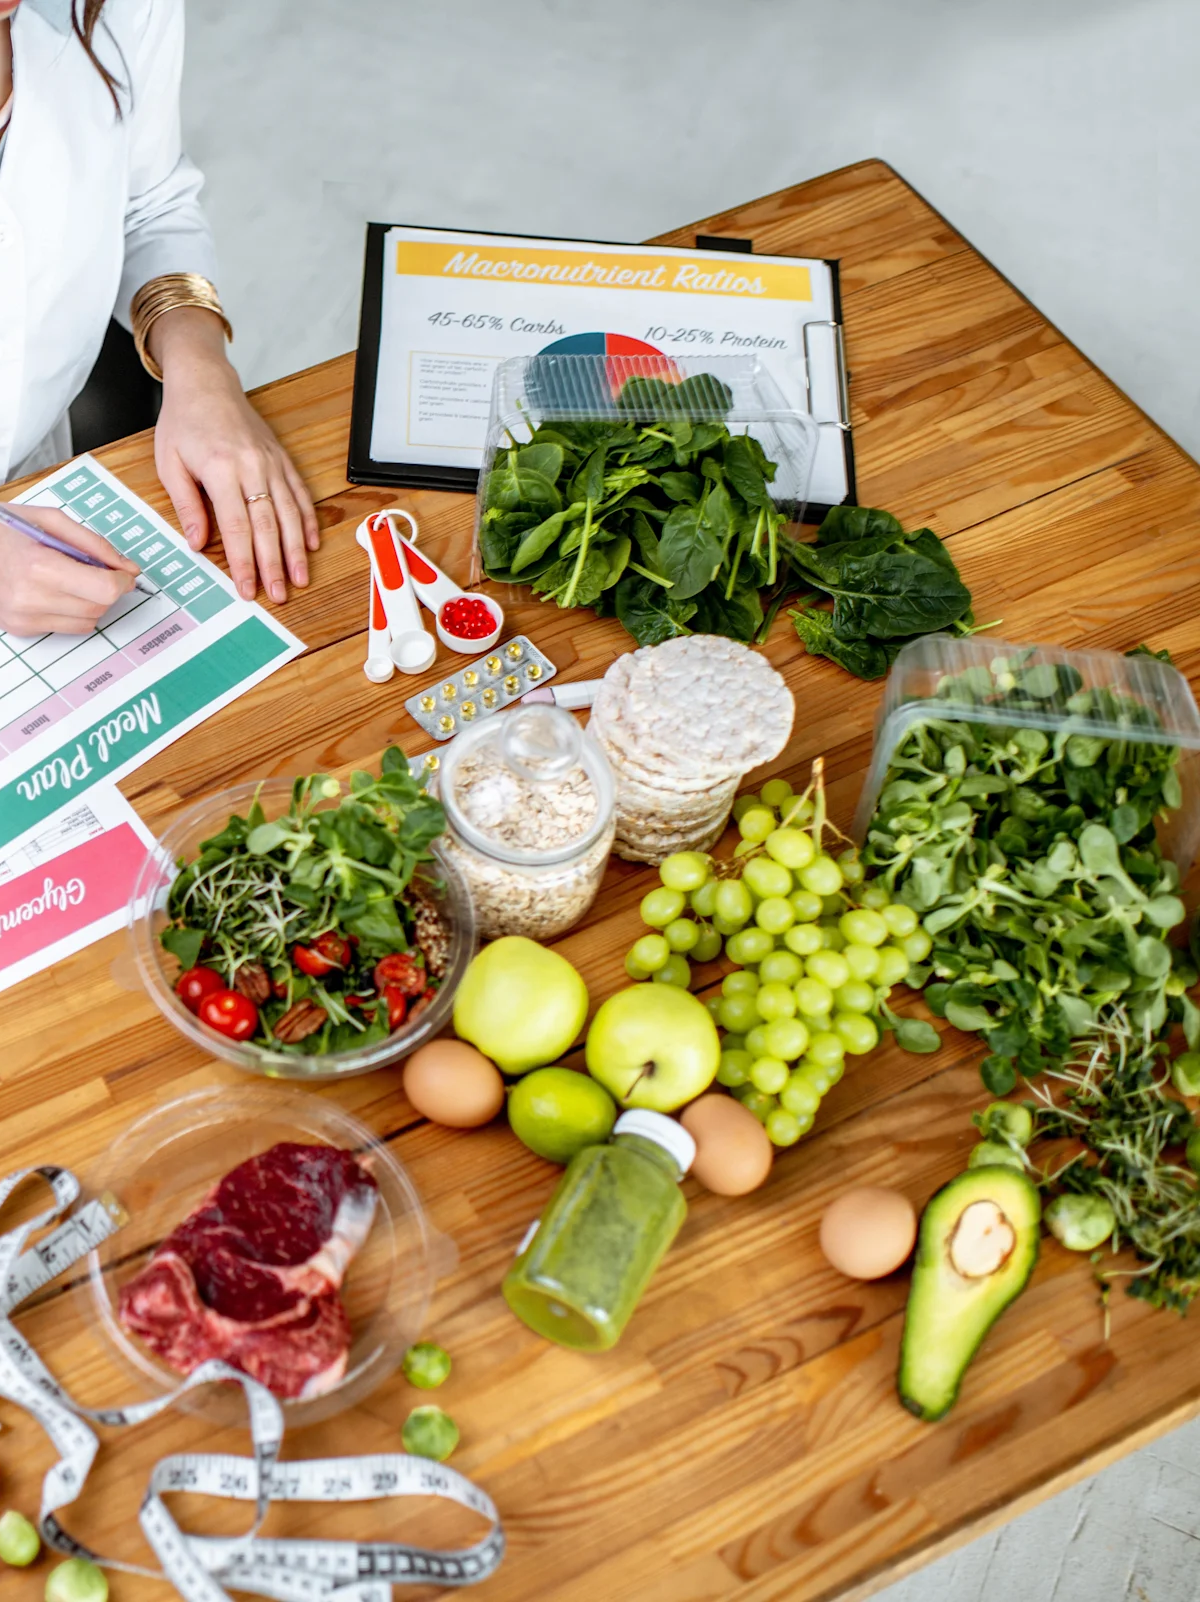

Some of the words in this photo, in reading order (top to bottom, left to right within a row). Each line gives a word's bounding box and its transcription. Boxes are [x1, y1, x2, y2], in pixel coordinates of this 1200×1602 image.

[444, 251, 667, 289] Macronutrient
[671, 262, 768, 295] Ratios
[428, 312, 503, 332] 45-65%
[509, 316, 566, 336] Carbs
[642, 326, 714, 346] 10-25%
[719, 331, 788, 352] Protein
[63, 474, 87, 491] sun
[105, 509, 123, 523] fri
[121, 524, 144, 541] thu
[138, 541, 165, 561] wed
[160, 559, 183, 576] tue
[177, 575, 204, 596] mon
[137, 622, 183, 655] breakfast
[83, 670, 113, 692] snack
[20, 713, 50, 735] lunch
[87, 691, 162, 762] Meal
[15, 743, 92, 800] Plan
[169, 1468, 198, 1488] 25
[220, 1472, 249, 1491] 26
[373, 1471, 399, 1490] 29
